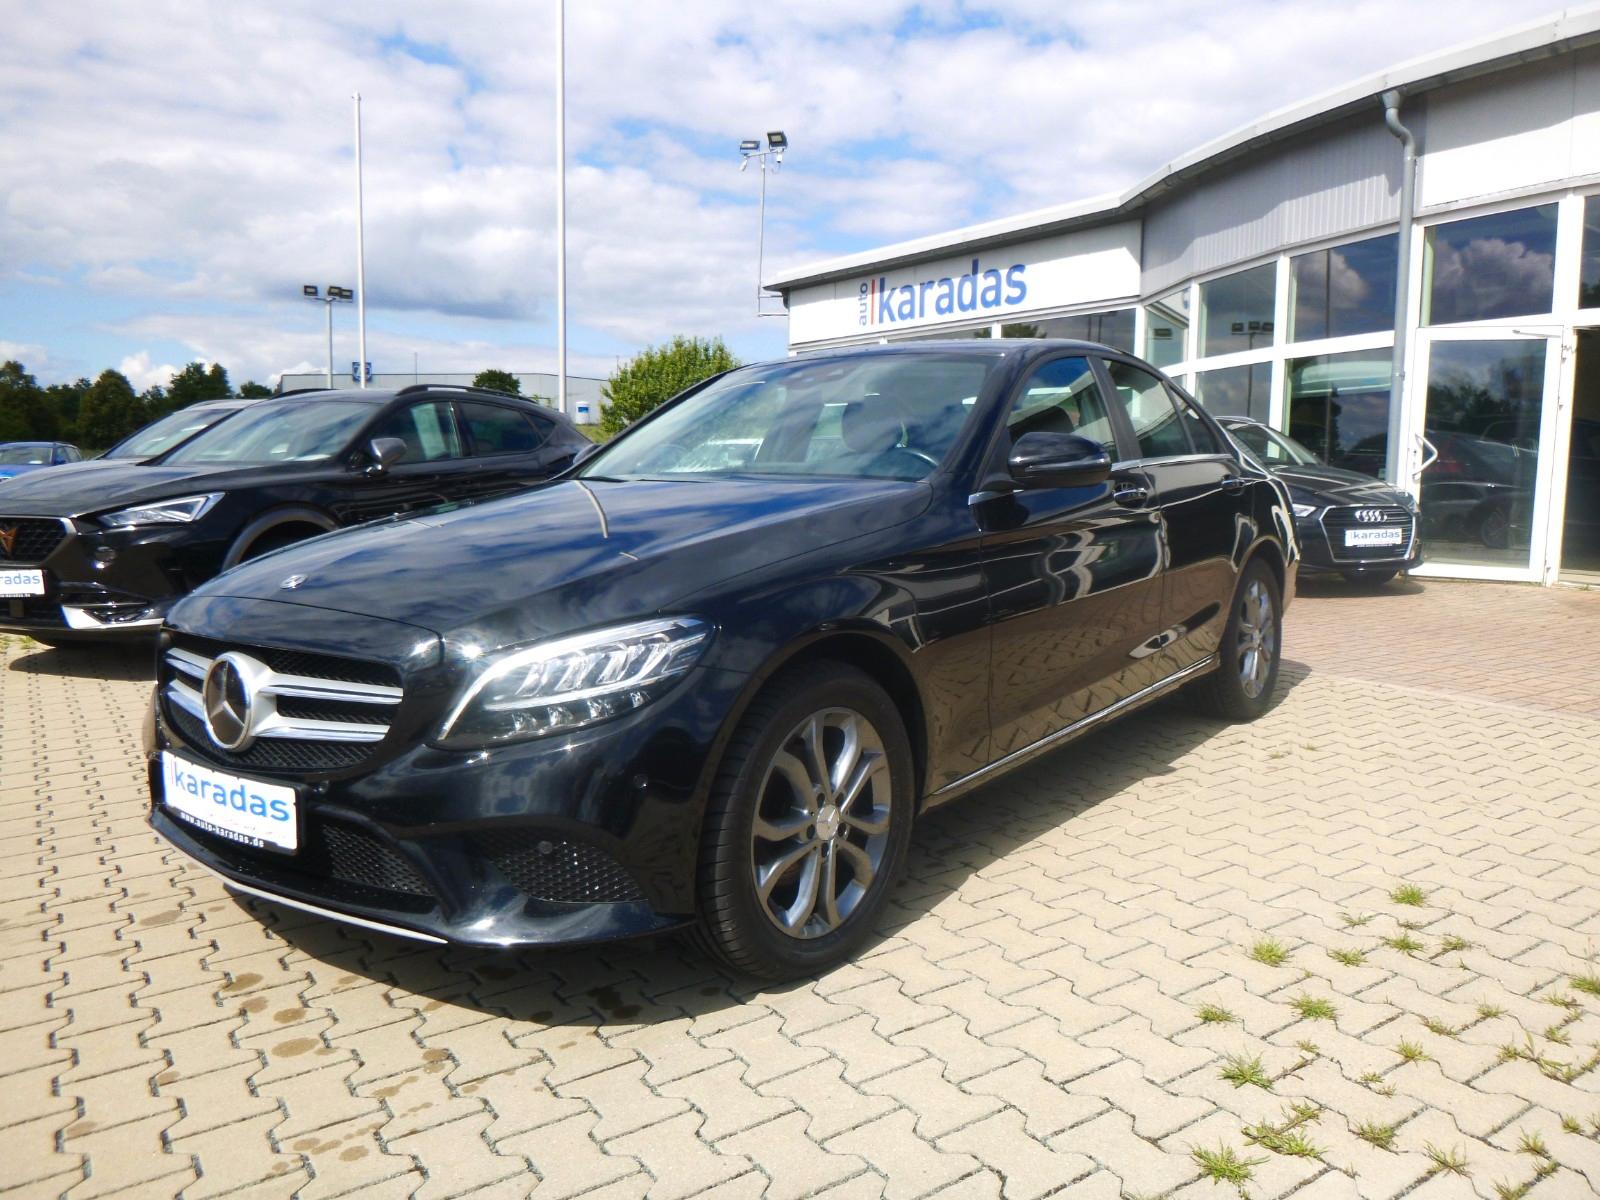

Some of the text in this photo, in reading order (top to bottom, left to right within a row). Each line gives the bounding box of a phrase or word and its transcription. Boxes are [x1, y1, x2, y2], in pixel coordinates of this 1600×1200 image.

[858, 282, 869, 326] auto
[878, 258, 1027, 324] karadas
[1353, 530, 1400, 540] karadas
[174, 761, 290, 822] karadas
[180, 812, 264, 848] www.auto-karadas.de
